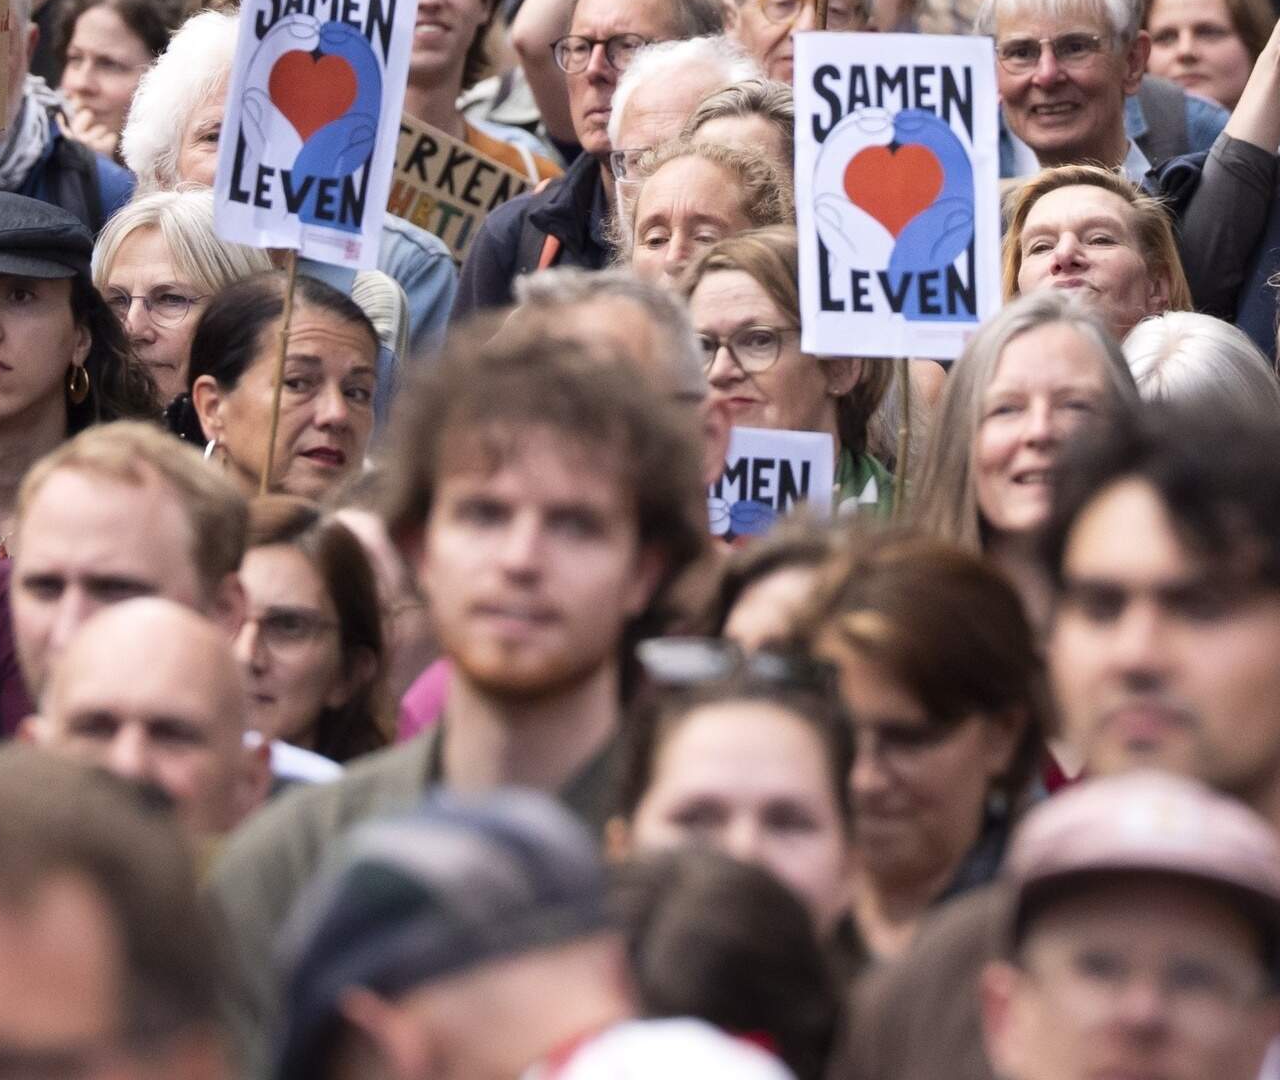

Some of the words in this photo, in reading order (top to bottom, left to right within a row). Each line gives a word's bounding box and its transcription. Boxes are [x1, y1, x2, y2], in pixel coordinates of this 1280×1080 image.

[811, 64, 974, 145] SAMEN
[228, 119, 371, 229] LEVEN
[398, 124, 529, 212] RKEN
[817, 230, 978, 316] LEVEN
[713, 456, 812, 515] MEN
